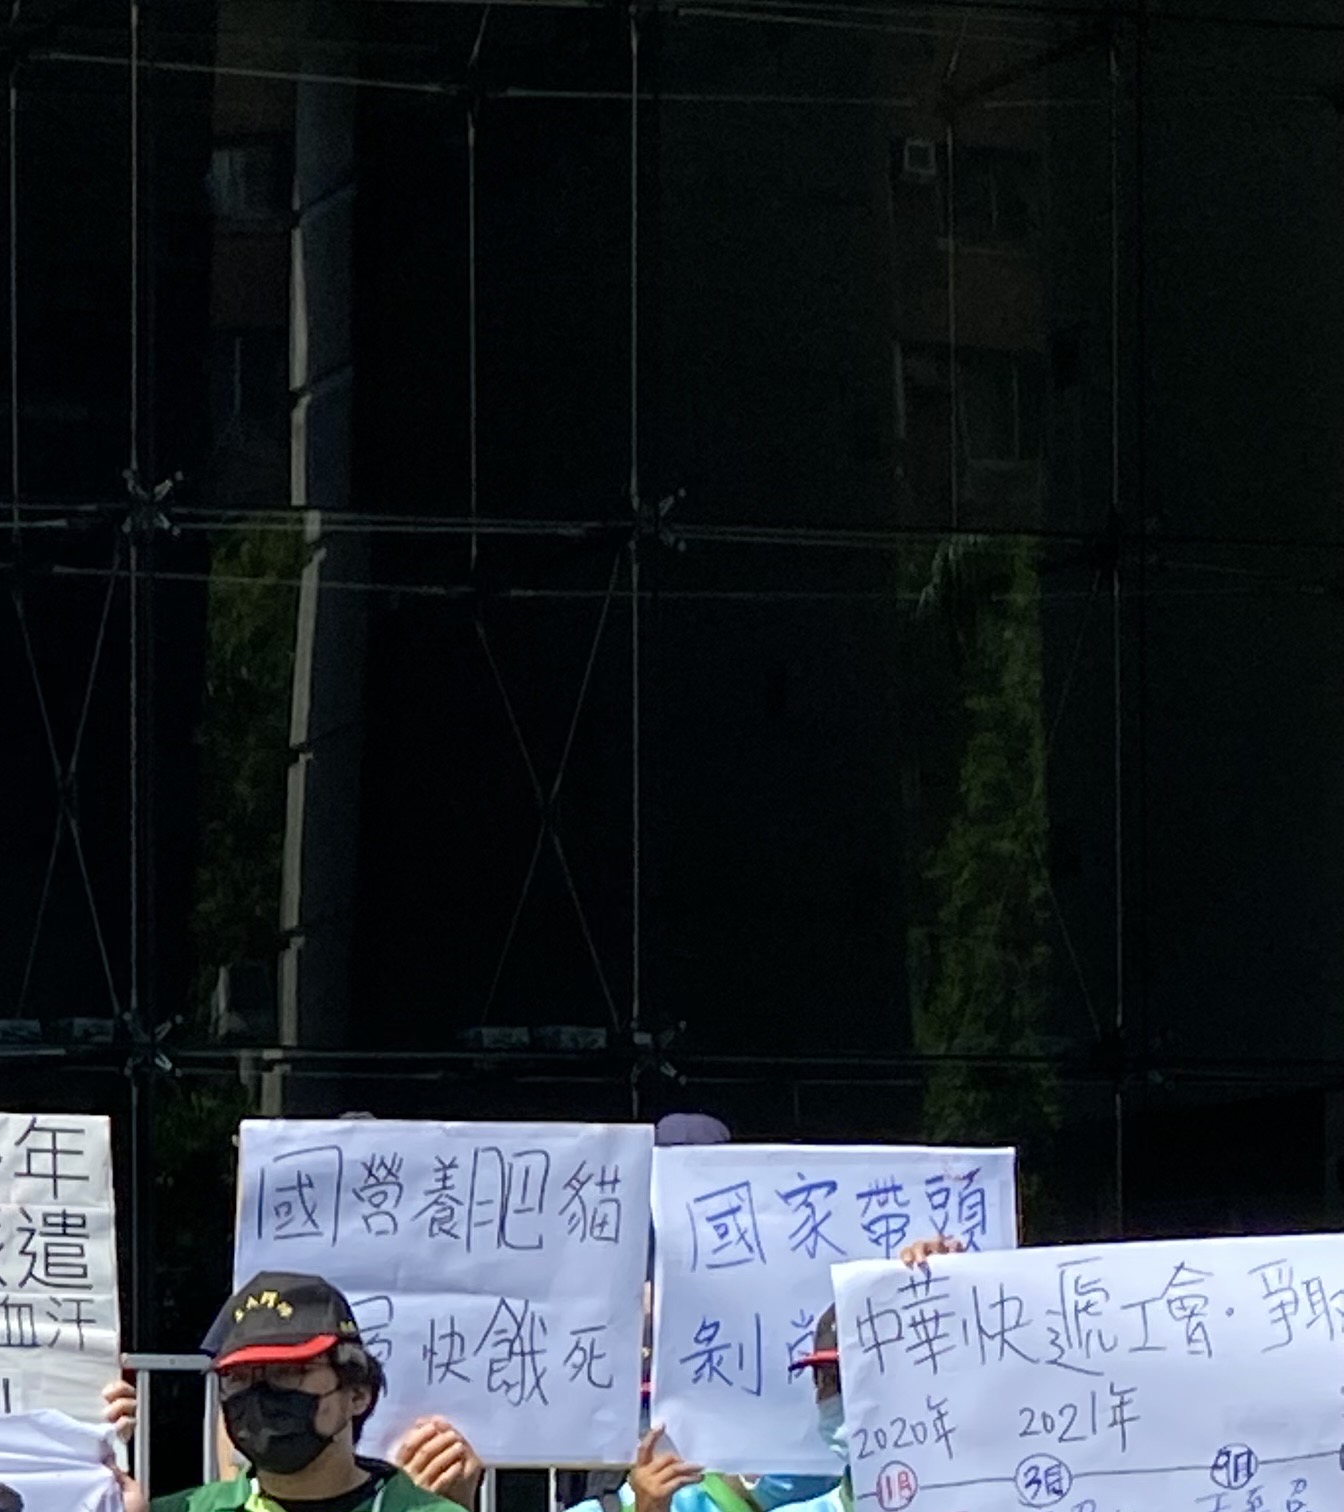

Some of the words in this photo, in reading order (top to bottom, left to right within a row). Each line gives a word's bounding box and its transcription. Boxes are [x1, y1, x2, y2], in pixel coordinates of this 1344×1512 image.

[257, 1144, 621, 1252] 國營養肥貓
[686, 1167, 987, 1273] 國家帶頭
[853, 1394, 959, 1461] 2020年
[1018, 1381, 1140, 1453] 2021年
[1023, 1467, 1066, 1499] 3月
[1214, 1449, 1255, 1486] 9月
